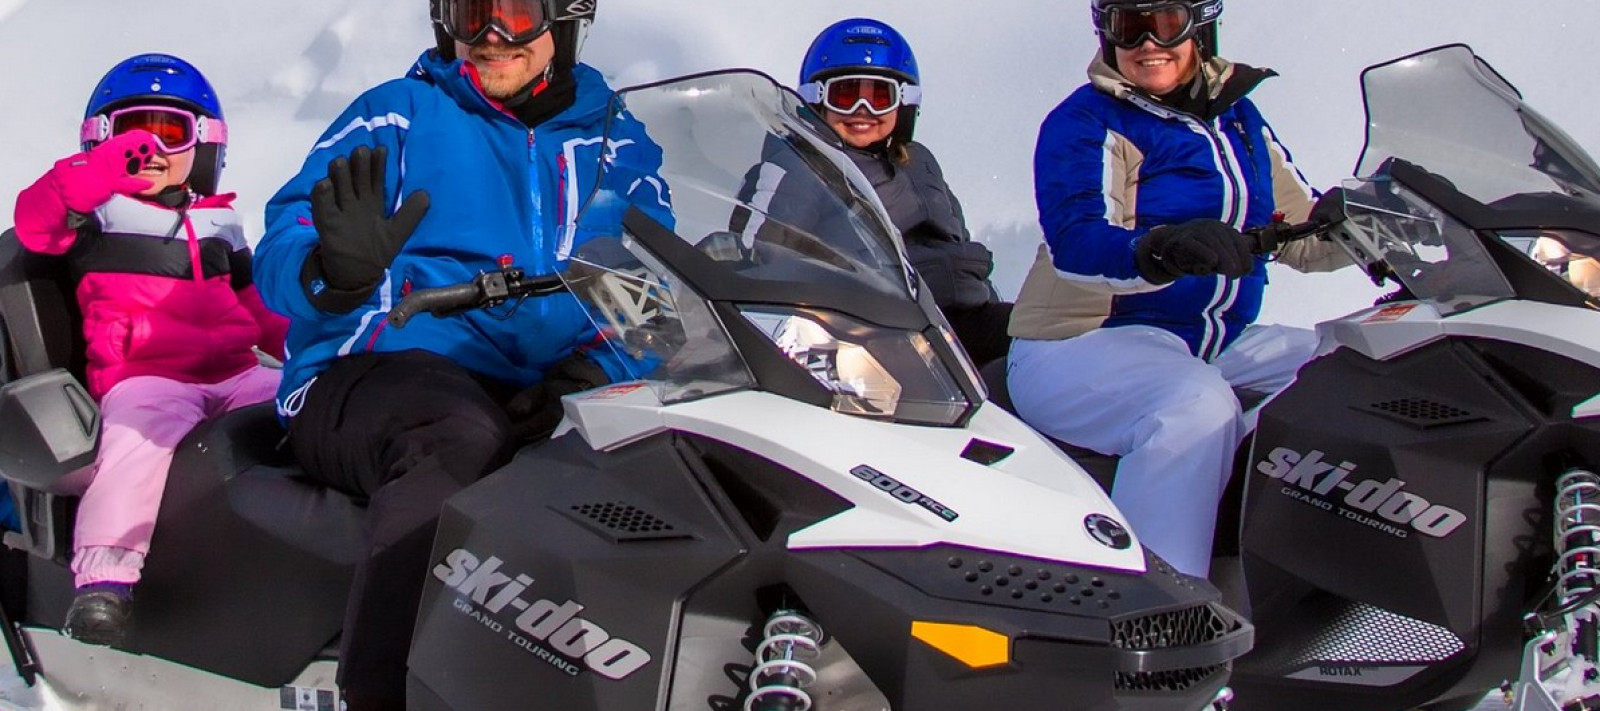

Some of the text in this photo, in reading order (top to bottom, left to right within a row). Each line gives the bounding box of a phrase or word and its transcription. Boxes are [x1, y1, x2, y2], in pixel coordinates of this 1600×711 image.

[850, 464, 922, 504] 600
[1280, 487, 1407, 538] GRAND TOURING
[453, 598, 580, 676] GRAND TOURING
[1319, 664, 1362, 676] ROTAX
